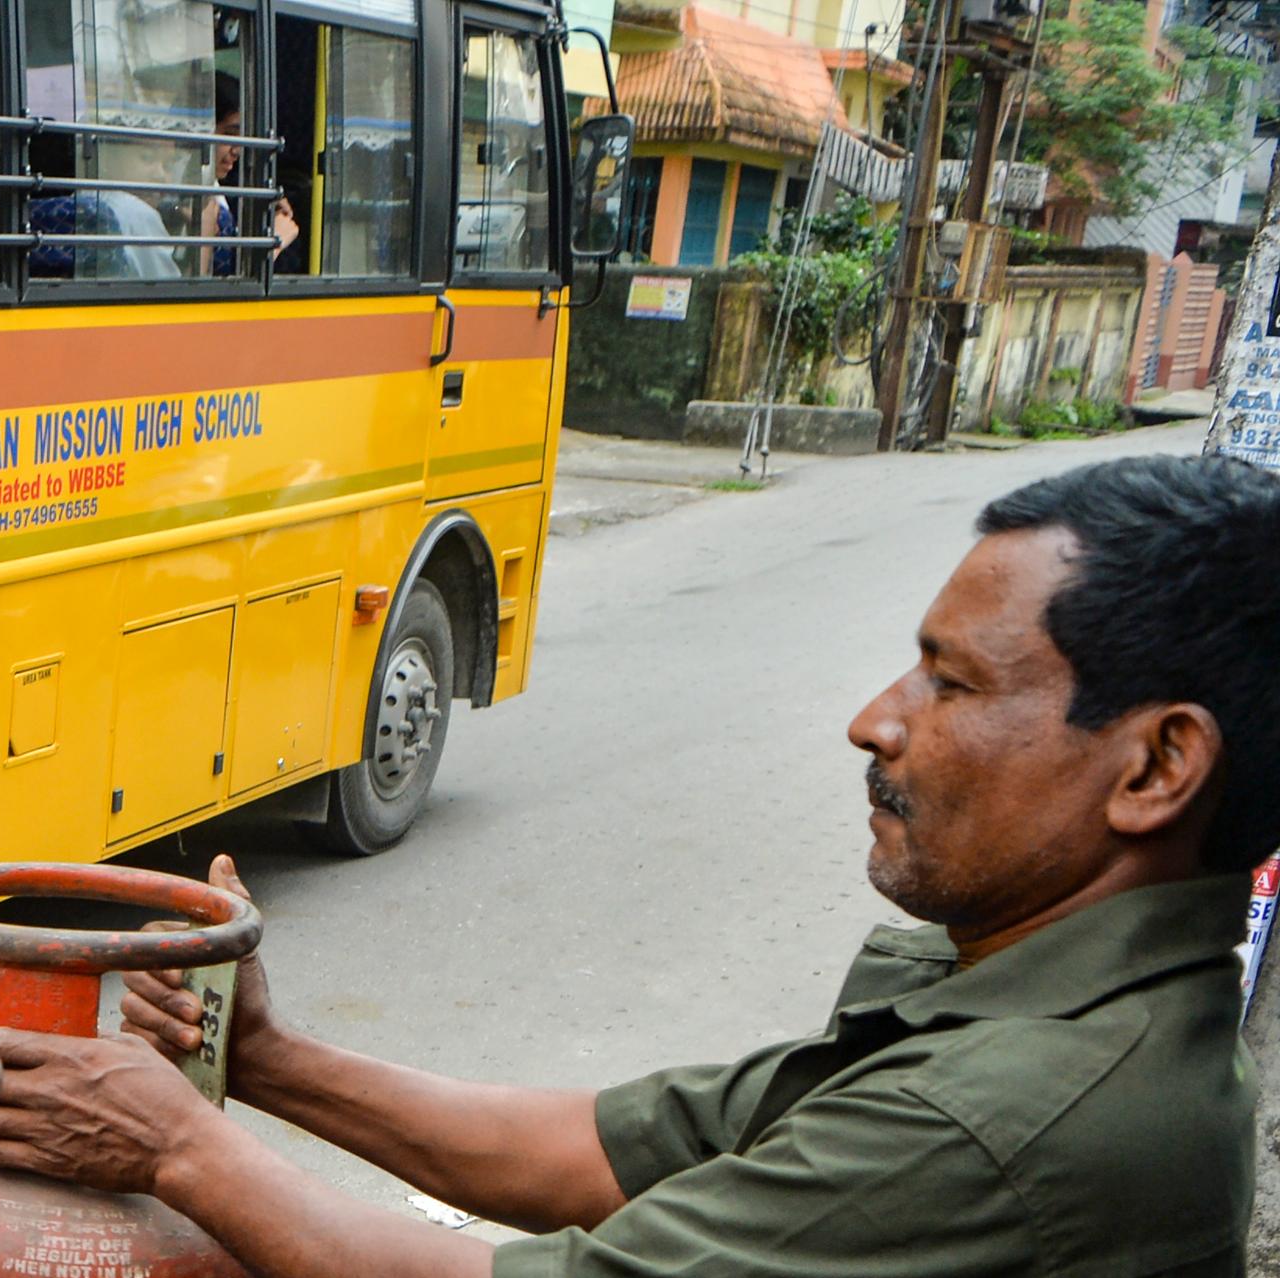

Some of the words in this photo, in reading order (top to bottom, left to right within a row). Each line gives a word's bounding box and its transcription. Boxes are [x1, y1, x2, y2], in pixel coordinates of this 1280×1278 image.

[35, 405, 125, 465] MISSION
[134, 400, 184, 452] HIGH
[193, 391, 263, 438] SCHOOL
[45, 470, 64, 501] to
[68, 462, 127, 493] WBBSE
[23, 1247, 132, 1266] REGULATOR
[99, 1238, 133, 1251] OFF
